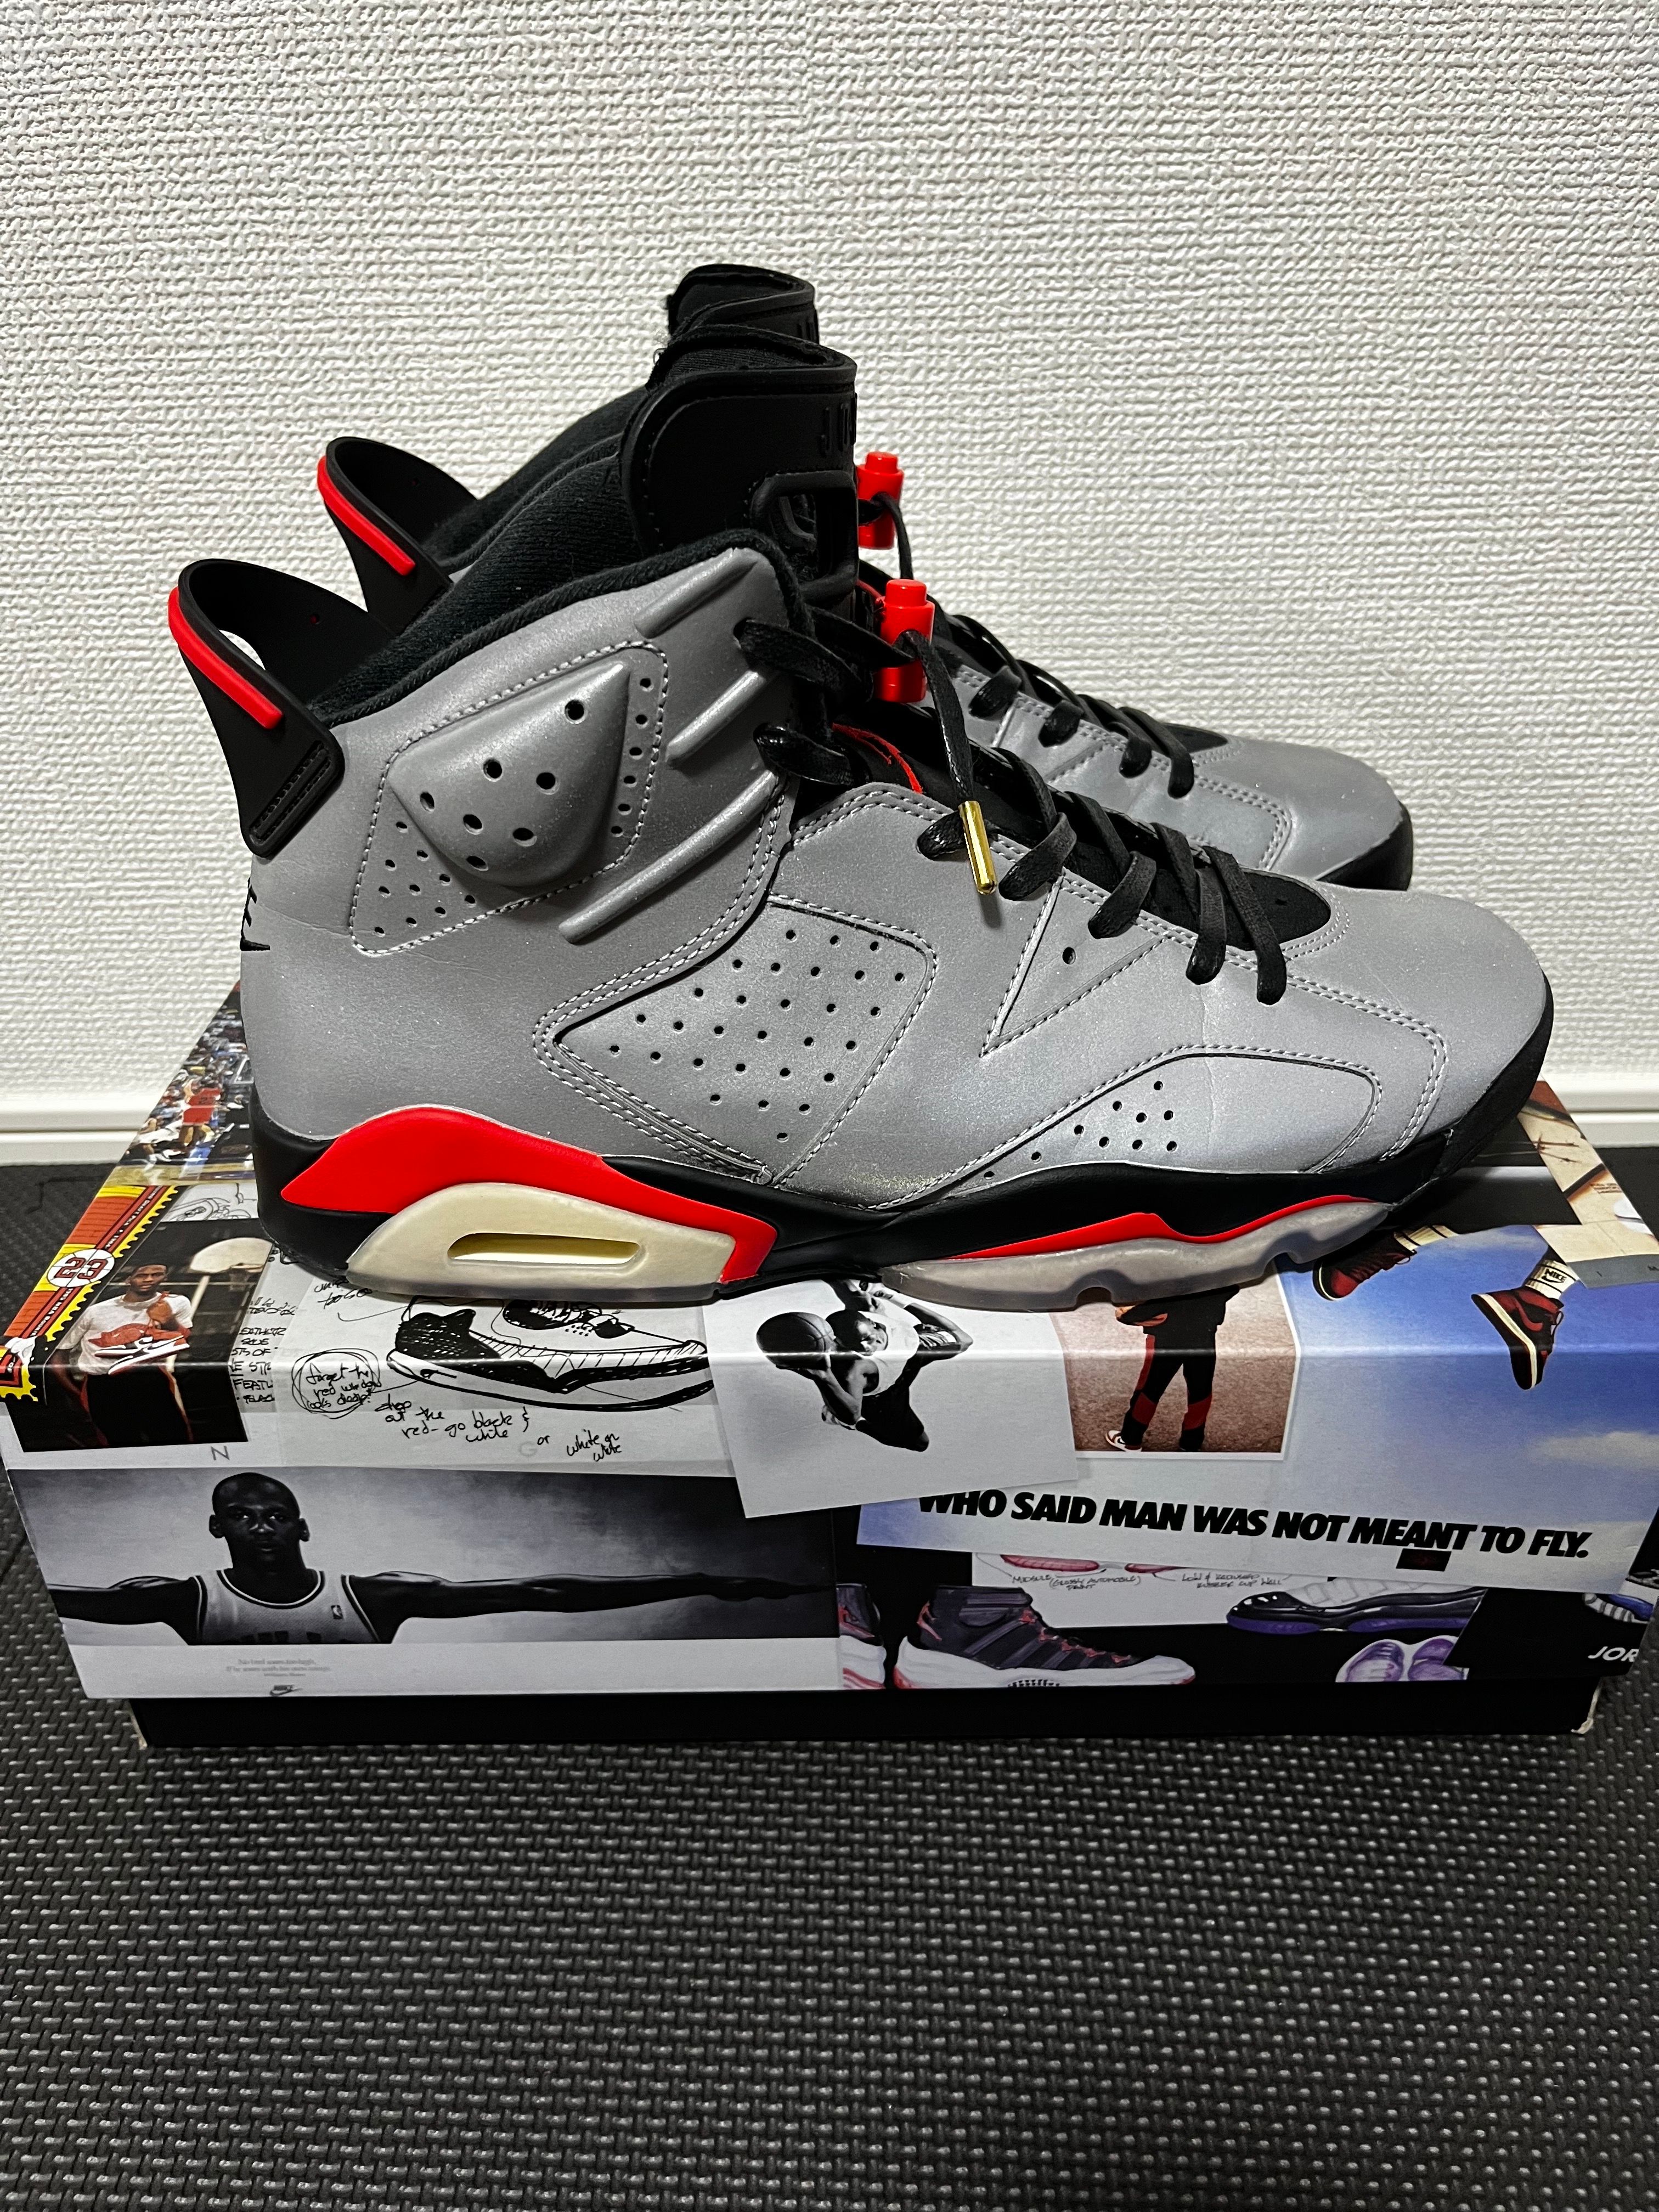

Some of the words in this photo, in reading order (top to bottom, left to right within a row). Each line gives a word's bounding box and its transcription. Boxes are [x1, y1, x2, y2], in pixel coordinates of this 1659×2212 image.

[53, 1257, 109, 1280] 23
[1544, 1268, 1567, 1282] NIKE
[48, 1302, 62, 1314] NBA
[306, 1362, 349, 1386] forget
[313, 1387, 336, 1402] red
[415, 1406, 445, 1421] the
[444, 1422, 466, 1438] go
[471, 1410, 514, 1429] black
[465, 1429, 509, 1442] white
[537, 1435, 550, 1446] or
[566, 1429, 600, 1457] white
[211, 1446, 230, 1461] N
[593, 1443, 623, 1462] white
[919, 1488, 1008, 1518] WHO
[1010, 1491, 1097, 1525] SAID
[1098, 1498, 1188, 1532] MAN
[1193, 1505, 1269, 1537] WAS
[1271, 1510, 1350, 1542] NOT
[1347, 1516, 1477, 1550] MEANT
[1481, 1525, 1525, 1555] TO
[1527, 1529, 1593, 1559] FLY.
[1588, 1646, 1639, 1662] JOR
